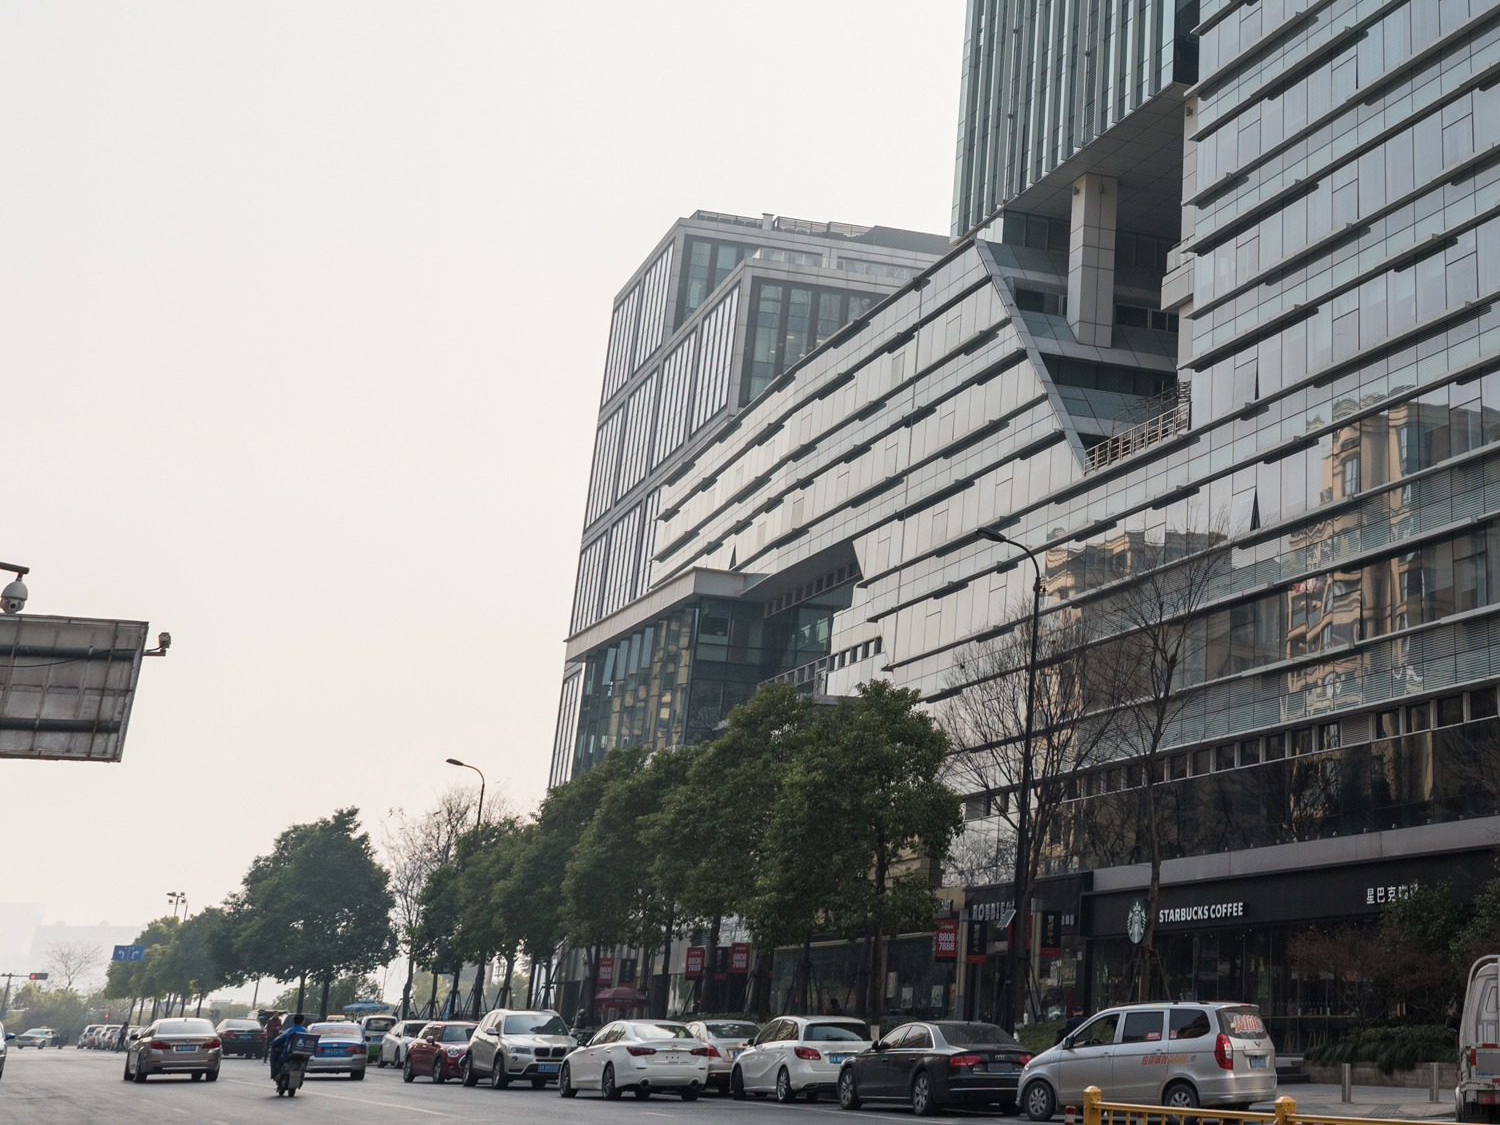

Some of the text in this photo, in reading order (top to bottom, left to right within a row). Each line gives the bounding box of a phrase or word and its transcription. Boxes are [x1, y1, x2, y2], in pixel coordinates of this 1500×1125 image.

[1366, 884, 1418, 904] 星巴克
[1159, 902, 1243, 923] STARBUCKS COFFEE
[938, 932, 955, 942] 8808
[938, 942, 955, 951] 7888
